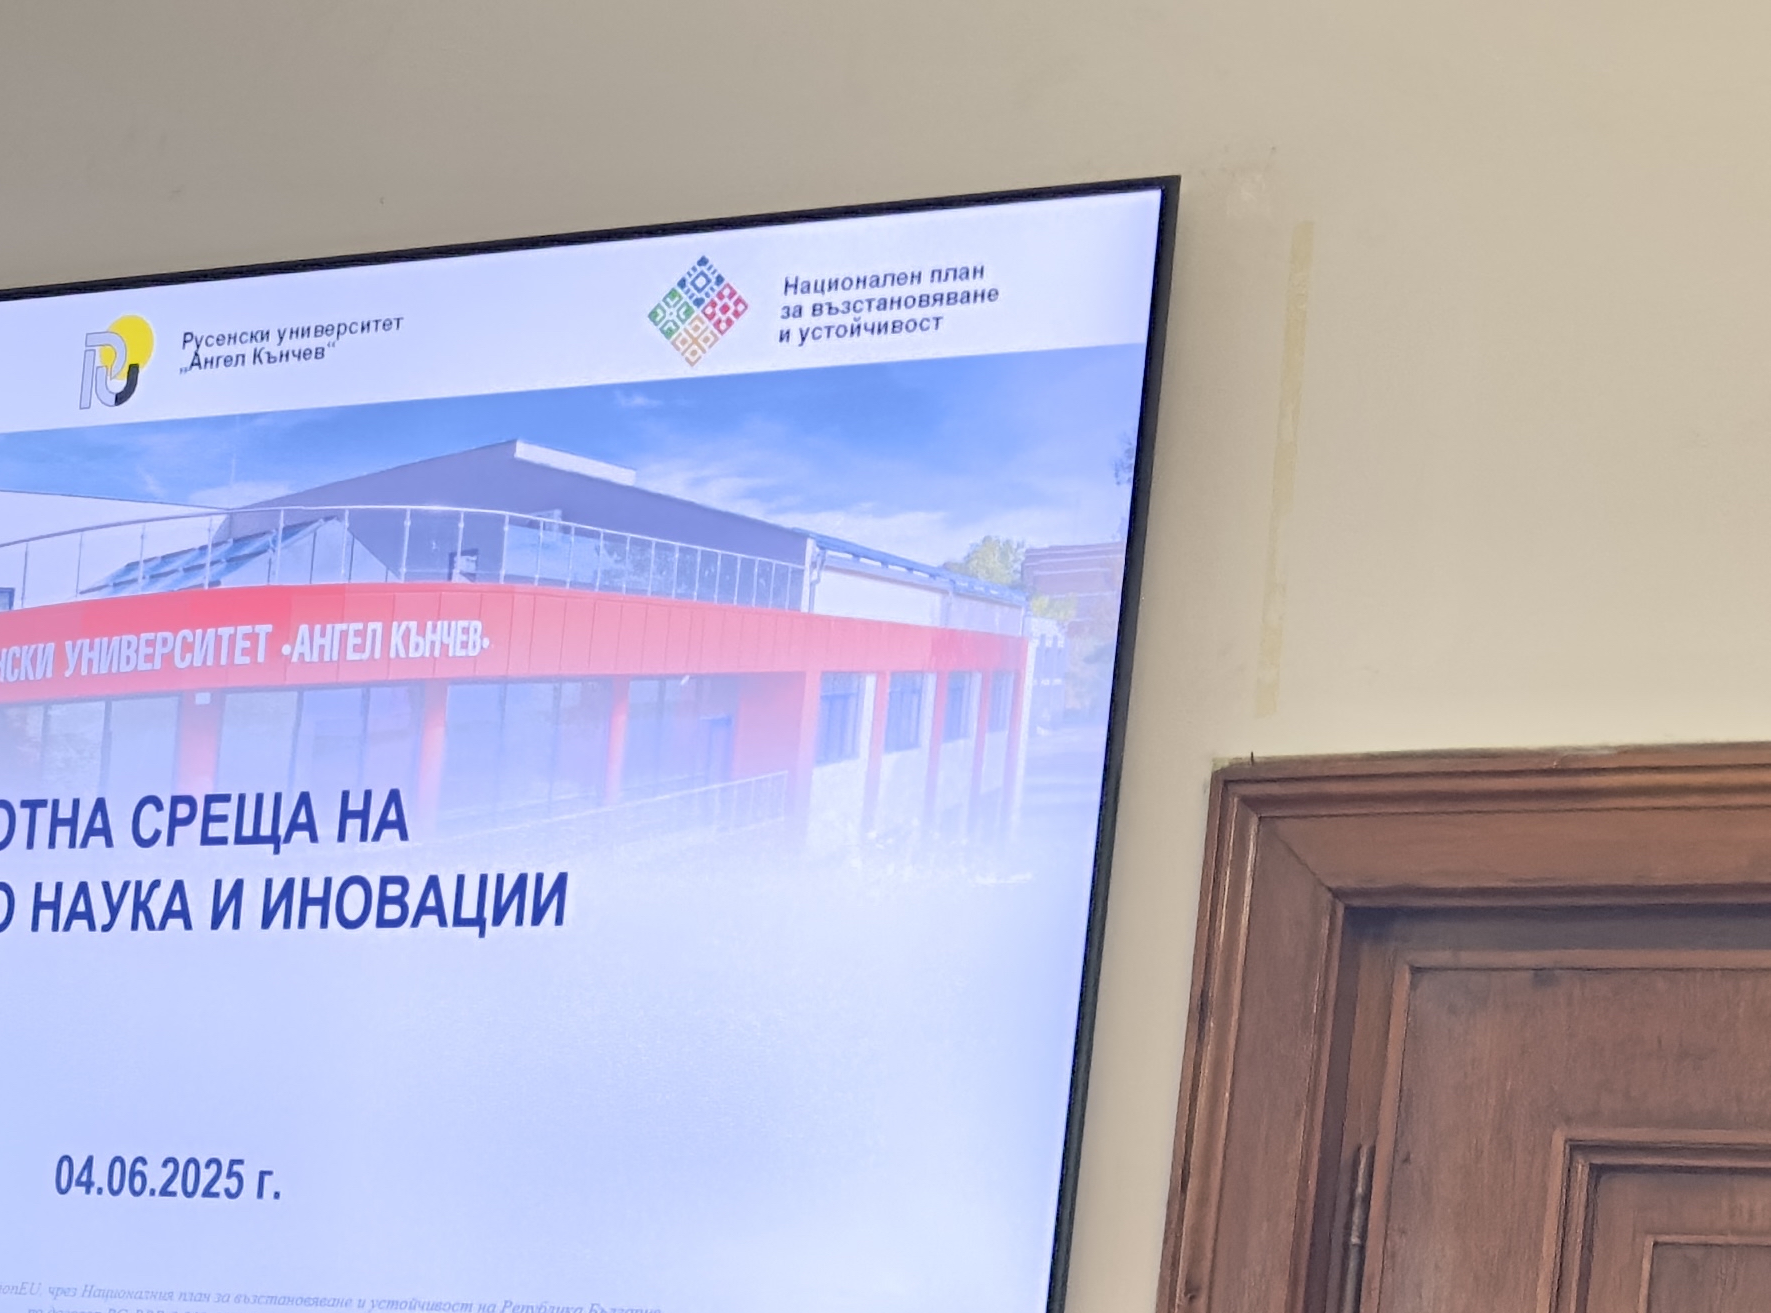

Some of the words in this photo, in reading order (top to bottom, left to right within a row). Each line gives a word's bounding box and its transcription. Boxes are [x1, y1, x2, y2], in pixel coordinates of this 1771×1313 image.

[784, 270, 921, 296] Национален
[929, 264, 984, 283] план
[780, 304, 802, 320] за
[811, 287, 999, 317] възстановяване
[182, 329, 270, 351] Русенски
[276, 317, 404, 347] университет
[778, 327, 790, 343] и
[798, 315, 943, 347] устойчивост
[179, 350, 246, 375] „Ангел
[252, 341, 336, 366] Кънчев“
[63, 624, 272, 678] УНИВЕРСИТЕТ
[131, 790, 320, 855] СРЕЩА
[337, 788, 409, 843] НА
[31, 878, 193, 932] НАУКА
[210, 878, 245, 930] И
[260, 872, 568, 938] ИНОВАЦИИ
[55, 1154, 245, 1200] 04.06.2025
[256, 1170, 281, 1200] г.
[213, 1294, 231, 1304] за
[357, 1298, 366, 1309] и
[478, 1303, 496, 1313] на
